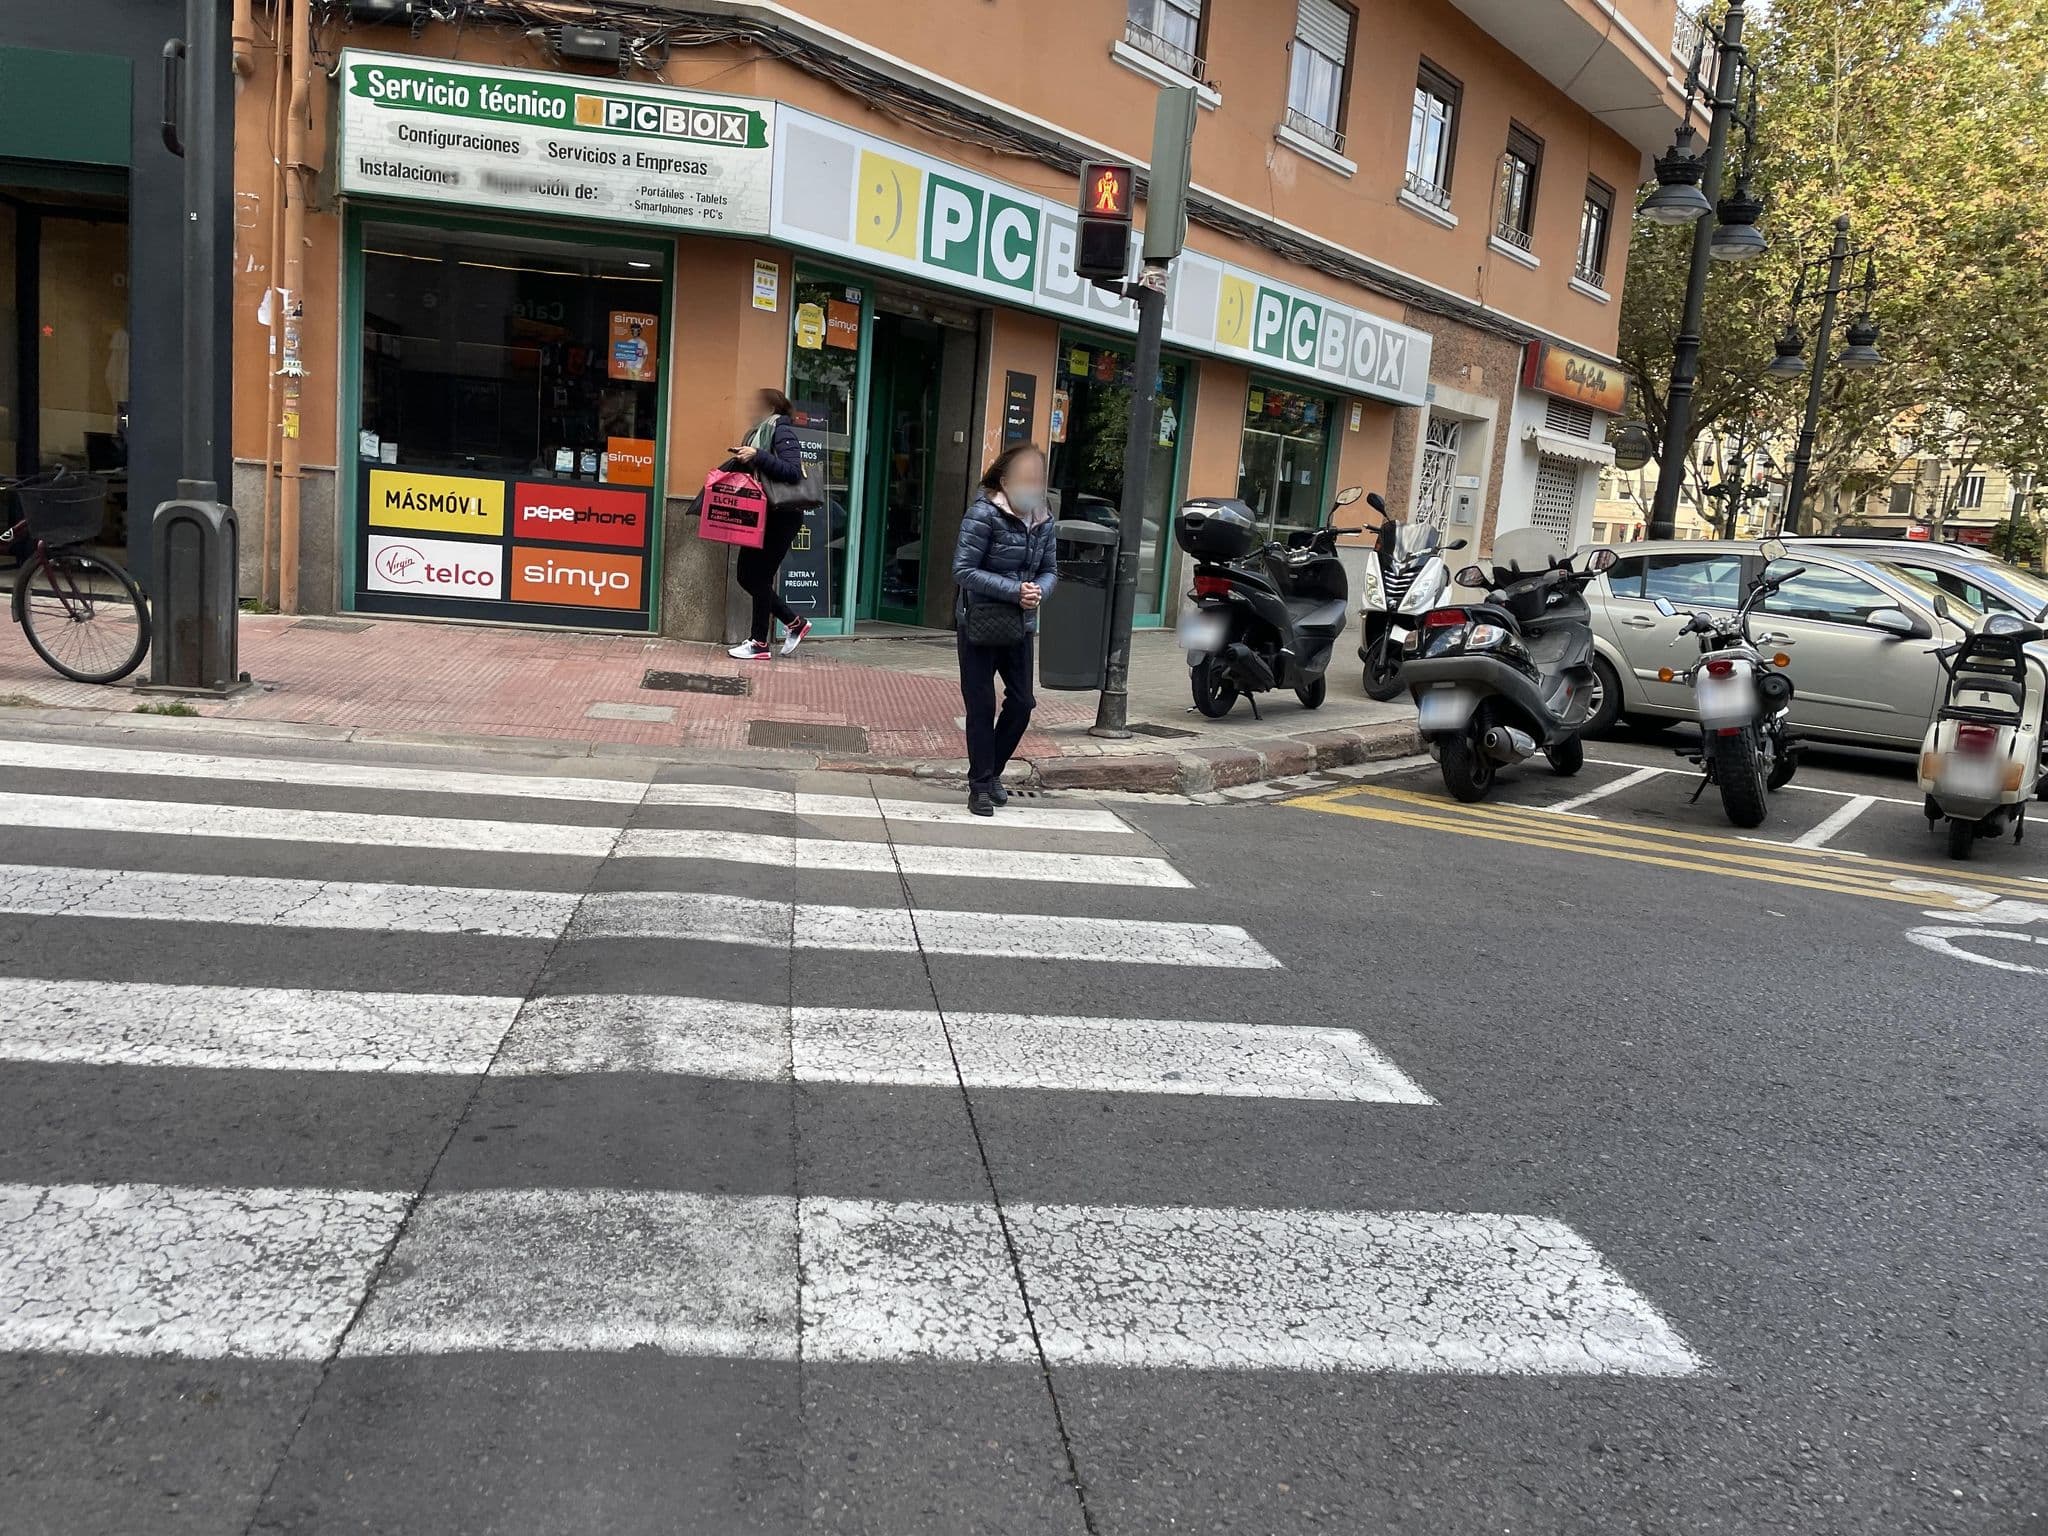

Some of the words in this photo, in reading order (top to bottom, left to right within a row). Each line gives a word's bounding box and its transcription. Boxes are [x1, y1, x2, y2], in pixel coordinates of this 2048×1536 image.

[368, 69, 470, 109] Servicio
[479, 83, 567, 120] técnico
[607, 102, 746, 142] PCBOX
[397, 125, 520, 154] Configuraciones
[547, 142, 617, 166] Servicios
[621, 154, 632, 168] a
[636, 153, 708, 176] Empresas
[575, 184, 599, 200] de:
[641, 186, 685, 200] Portátiles
[695, 192, 728, 205] Tablets
[634, 200, 694, 215] Smartphones
[703, 209, 724, 220] PC's
[614, 313, 654, 328] simyo
[828, 317, 858, 333] simyo
[1257, 292, 1406, 388] PCBOX
[807, 441, 822, 450] CON
[608, 451, 652, 468] simyo
[713, 495, 739, 507] ELCHE
[523, 505, 637, 526] pepephone
[386, 551, 416, 577] Virgin
[424, 563, 494, 587] telco
[523, 559, 630, 596] simyo
